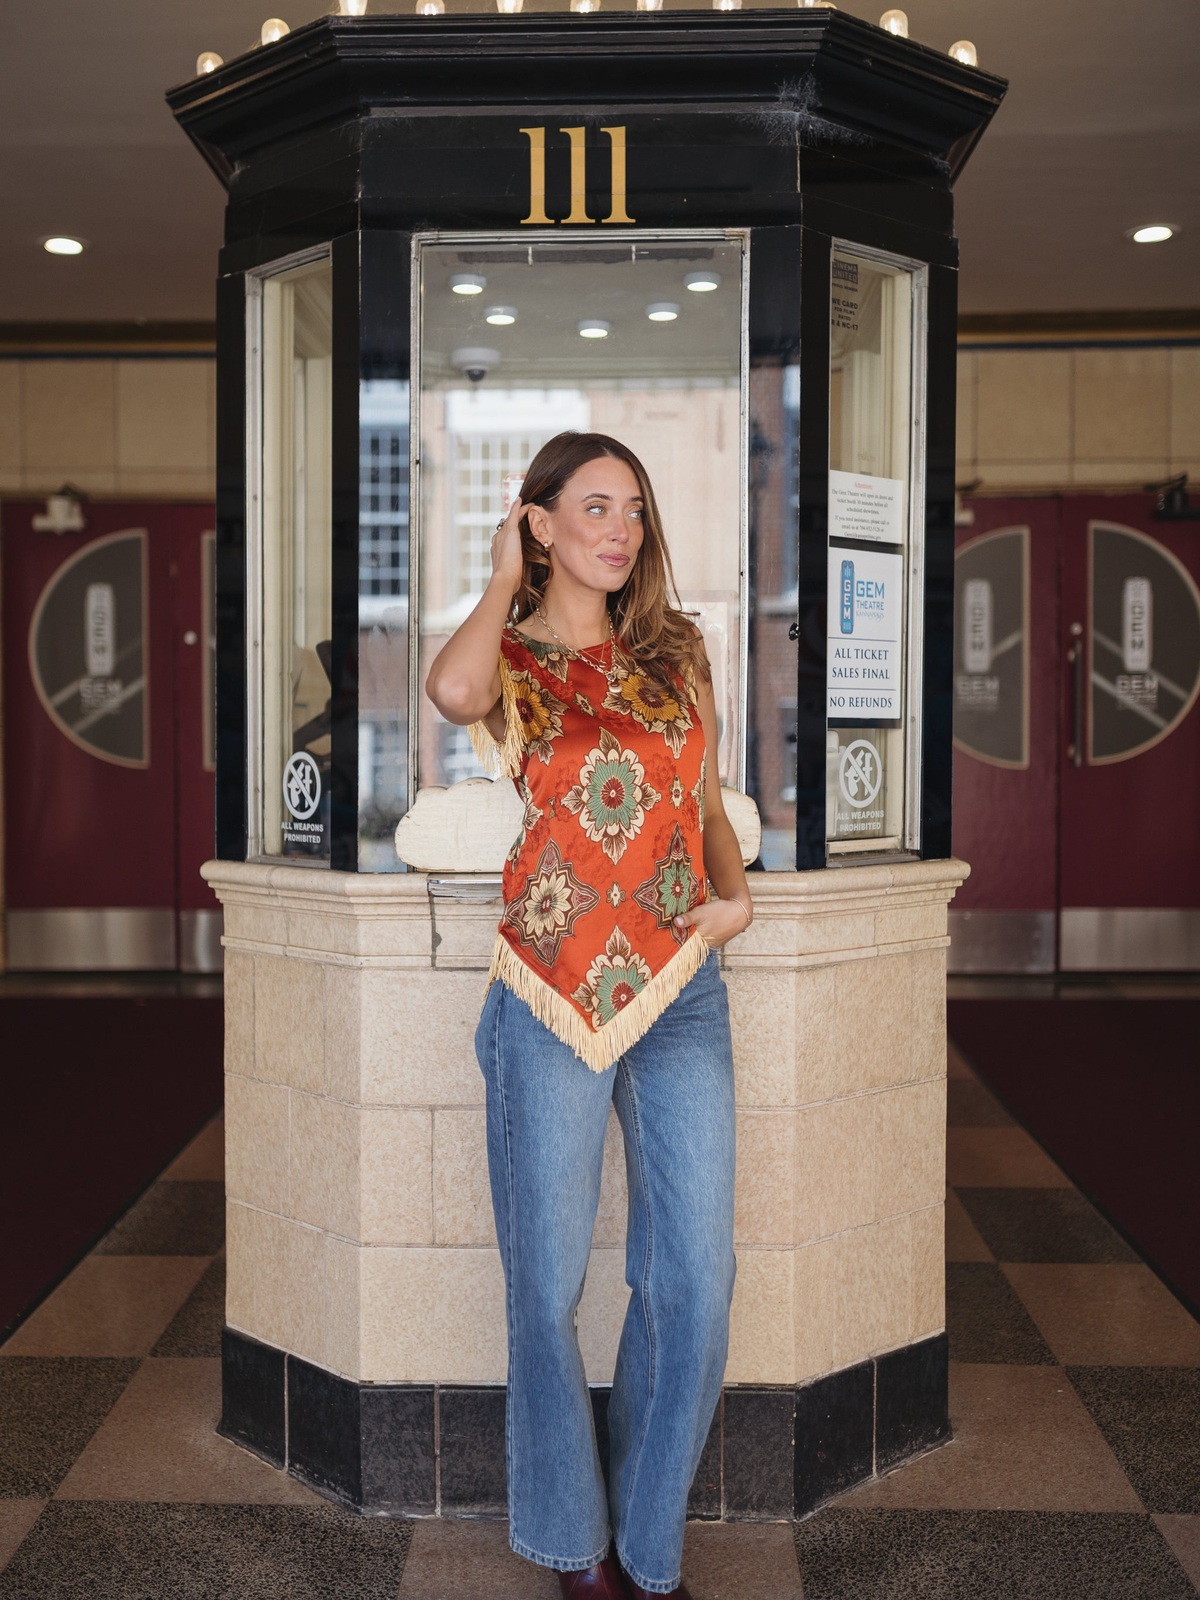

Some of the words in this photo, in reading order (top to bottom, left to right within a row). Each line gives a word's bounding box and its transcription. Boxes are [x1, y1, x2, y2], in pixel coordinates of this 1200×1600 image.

[519, 126, 636, 224] 111
[832, 261, 857, 273] CINEMA
[832, 269, 857, 282] UNITED
[832, 298, 841, 306] WE
[842, 300, 858, 310] CARD
[843, 308, 855, 316] FILMS
[842, 321, 858, 331] NC-17
[856, 580, 885, 599] GEM
[843, 579, 851, 620] GEM
[856, 600, 885, 611] THEATRE
[834, 648, 852, 660] ALL
[854, 648, 889, 661] TICKET
[832, 667, 859, 679] SALES
[862, 668, 890, 680] FINAL
[829, 696, 846, 708] NO
[848, 697, 892, 709] REFUNDS
[836, 811, 850, 820] ALL
[851, 810, 884, 820] WEAPONS
[281, 821, 292, 830] ALL
[293, 822, 324, 832] WEAPONS
[839, 822, 881, 832] PROHIBITED
[283, 833, 321, 844] PROHIBITED
